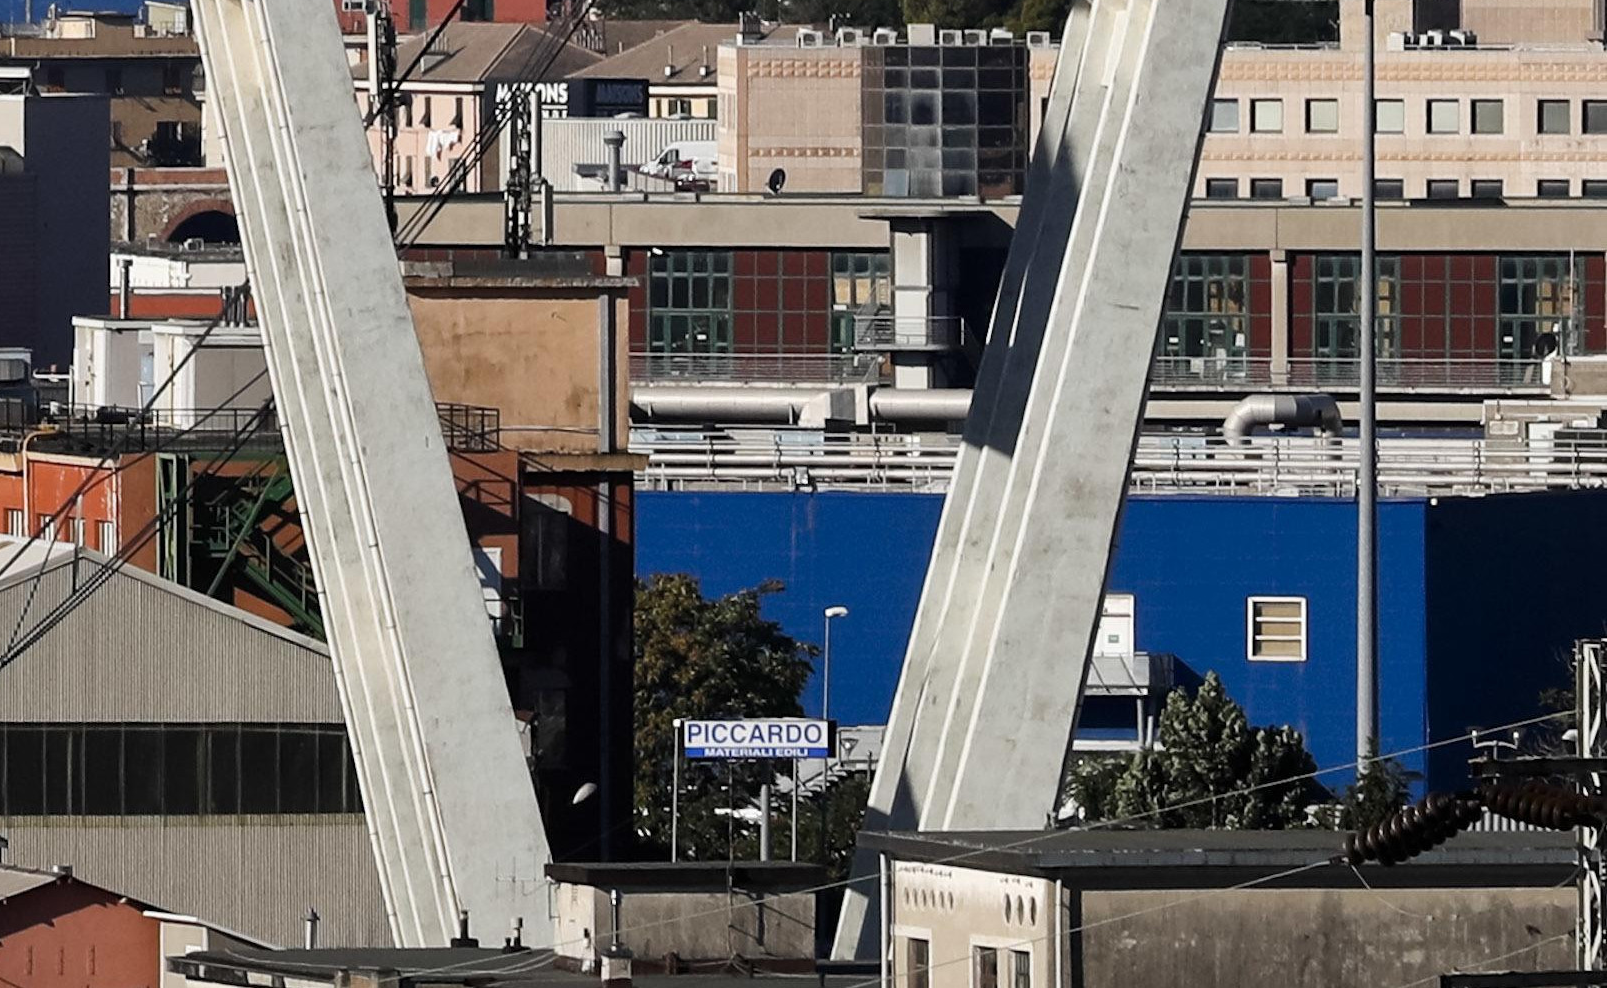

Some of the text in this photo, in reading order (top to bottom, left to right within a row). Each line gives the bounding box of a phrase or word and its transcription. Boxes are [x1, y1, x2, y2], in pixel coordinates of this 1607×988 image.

[688, 723, 822, 744] PICCARDO
[704, 747, 809, 758] MATERIALI EDILI
